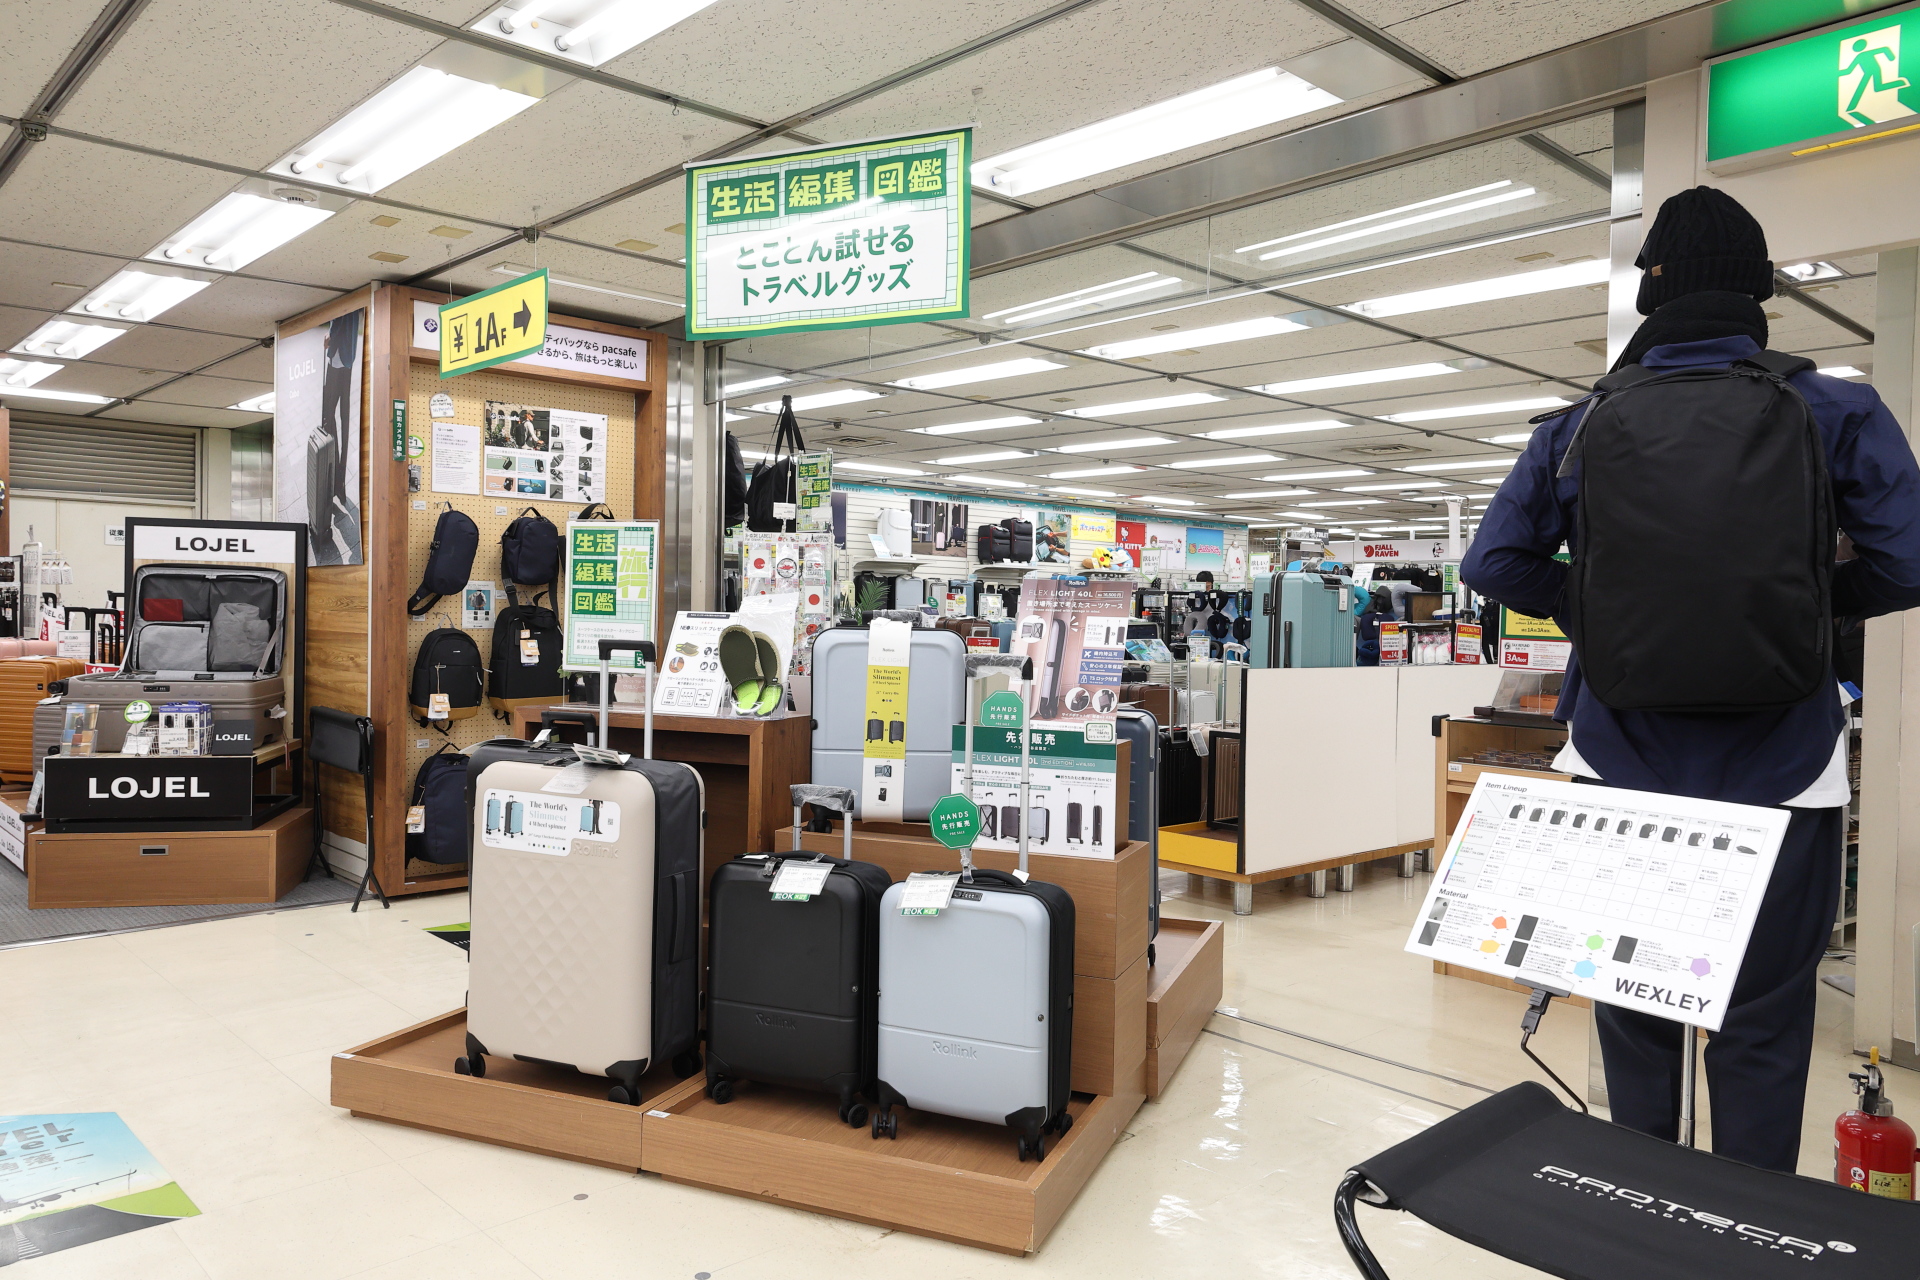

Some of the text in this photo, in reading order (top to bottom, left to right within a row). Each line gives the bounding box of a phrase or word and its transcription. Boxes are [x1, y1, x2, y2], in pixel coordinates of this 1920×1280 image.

[710, 157, 943, 218] 生活 編集 図鑑
[735, 223, 915, 271] とことん試せる
[743, 258, 915, 306] トラベルグッズ
[602, 344, 638, 358] pacsafe
[289, 358, 317, 381] LOJEL
[947, 495, 964, 503] TRAVEL
[1052, 505, 1066, 513] TRAVEL
[175, 536, 255, 553] LOJEL
[575, 533, 616, 553] 生活
[575, 562, 615, 582] 編集
[618, 547, 648, 599] 旅行
[575, 592, 614, 612] 図鑑
[1026, 600, 1123, 609] 置き場所まで考えたスーツケース
[994, 755, 1020, 764] LIGHT
[88, 776, 210, 799] LOJEL
[1503, 783, 1528, 793] Lineup
[530, 801, 568, 811] The World's
[529, 810, 567, 822] Slimmest
[940, 810, 970, 821] HANDS
[533, 821, 548, 829] Wheel
[548, 822, 567, 831] spinner
[941, 819, 972, 831] 先行販売
[573, 841, 619, 859] Rollink
[1438, 888, 1469, 900] Material
[1615, 977, 1712, 1014] WEXLEY
[755, 1012, 797, 1030] Rollink
[932, 1040, 978, 1060] Rollink
[1532, 1173, 1816, 1262] QUALITY MADE IN JAPAN
